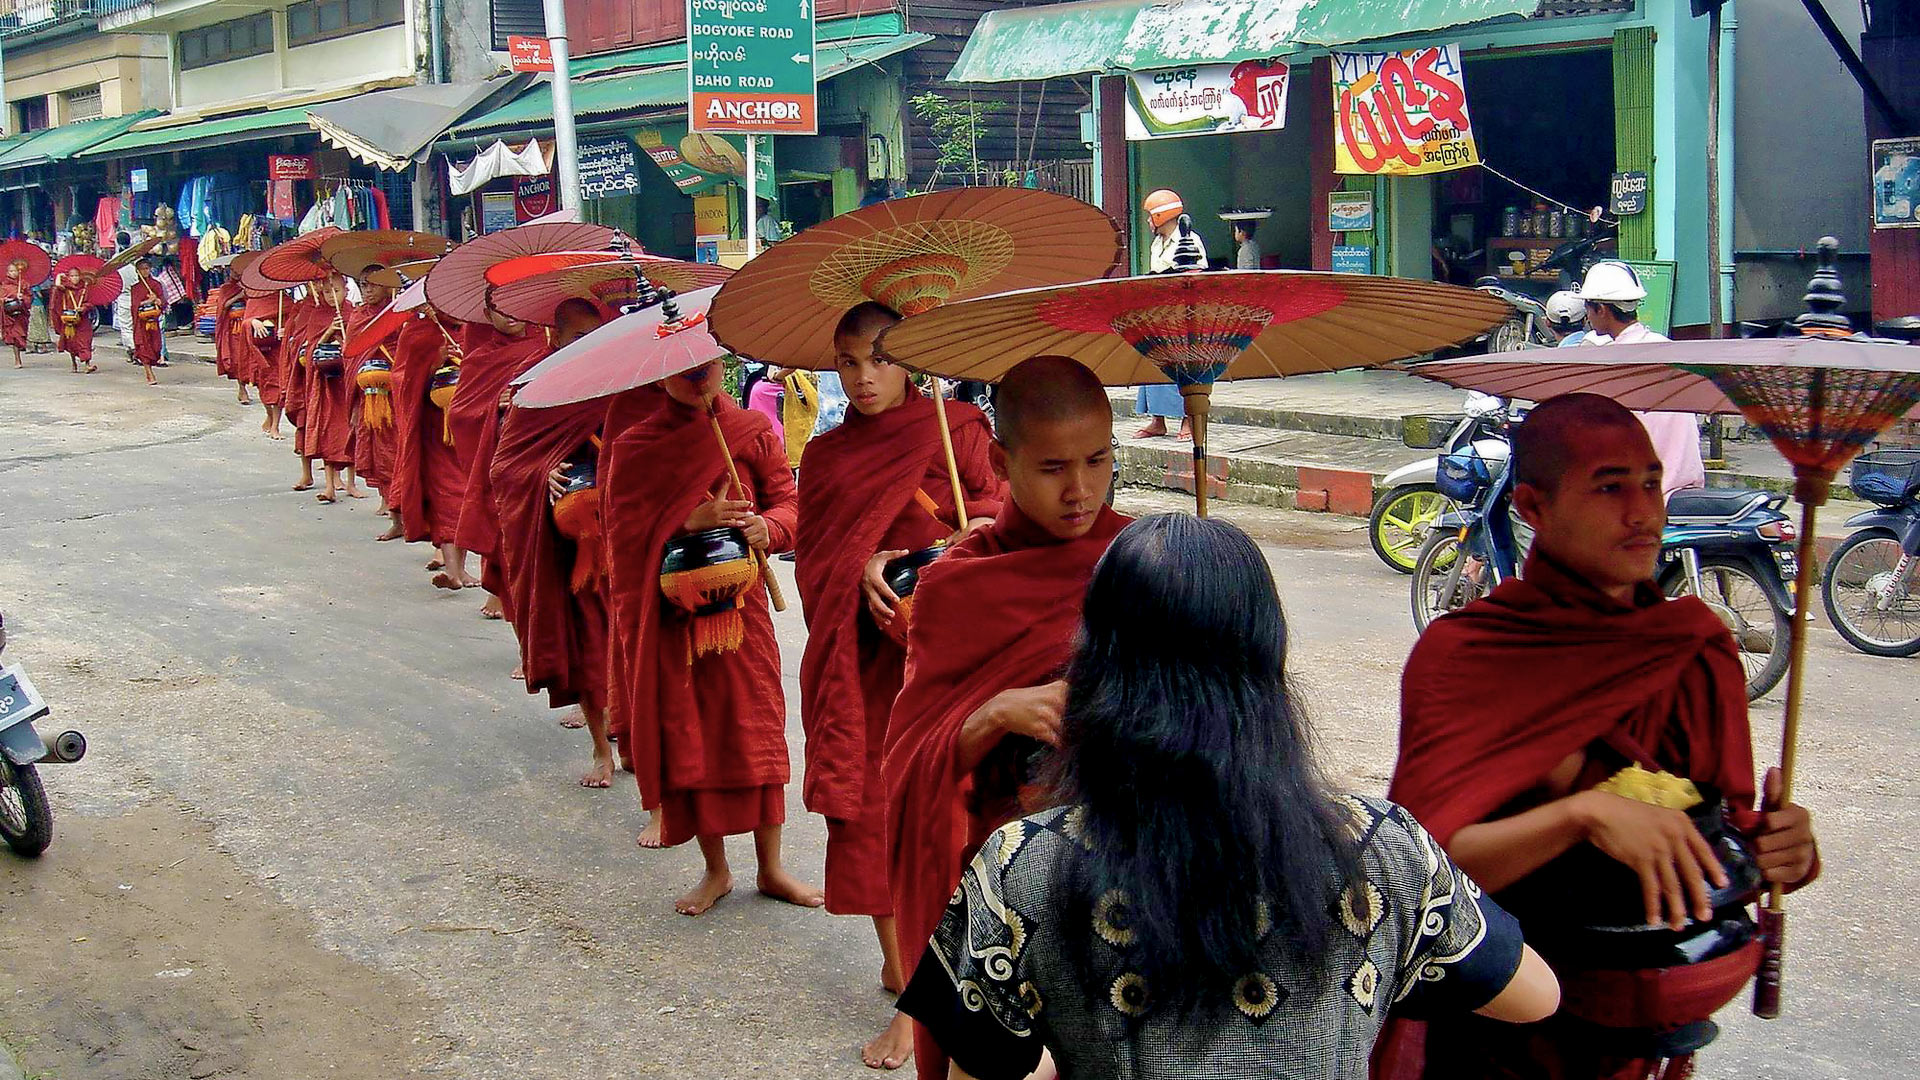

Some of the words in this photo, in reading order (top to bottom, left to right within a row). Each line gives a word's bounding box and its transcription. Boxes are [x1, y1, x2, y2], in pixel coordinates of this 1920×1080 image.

[693, 24, 755, 37] BOGYOKE
[760, 27, 793, 39] ROAD
[695, 75, 731, 87] BAHO
[739, 76, 774, 88] ROAD
[706, 98, 801, 120] ANCHOR
[518, 181, 551, 197] ANCHOR
